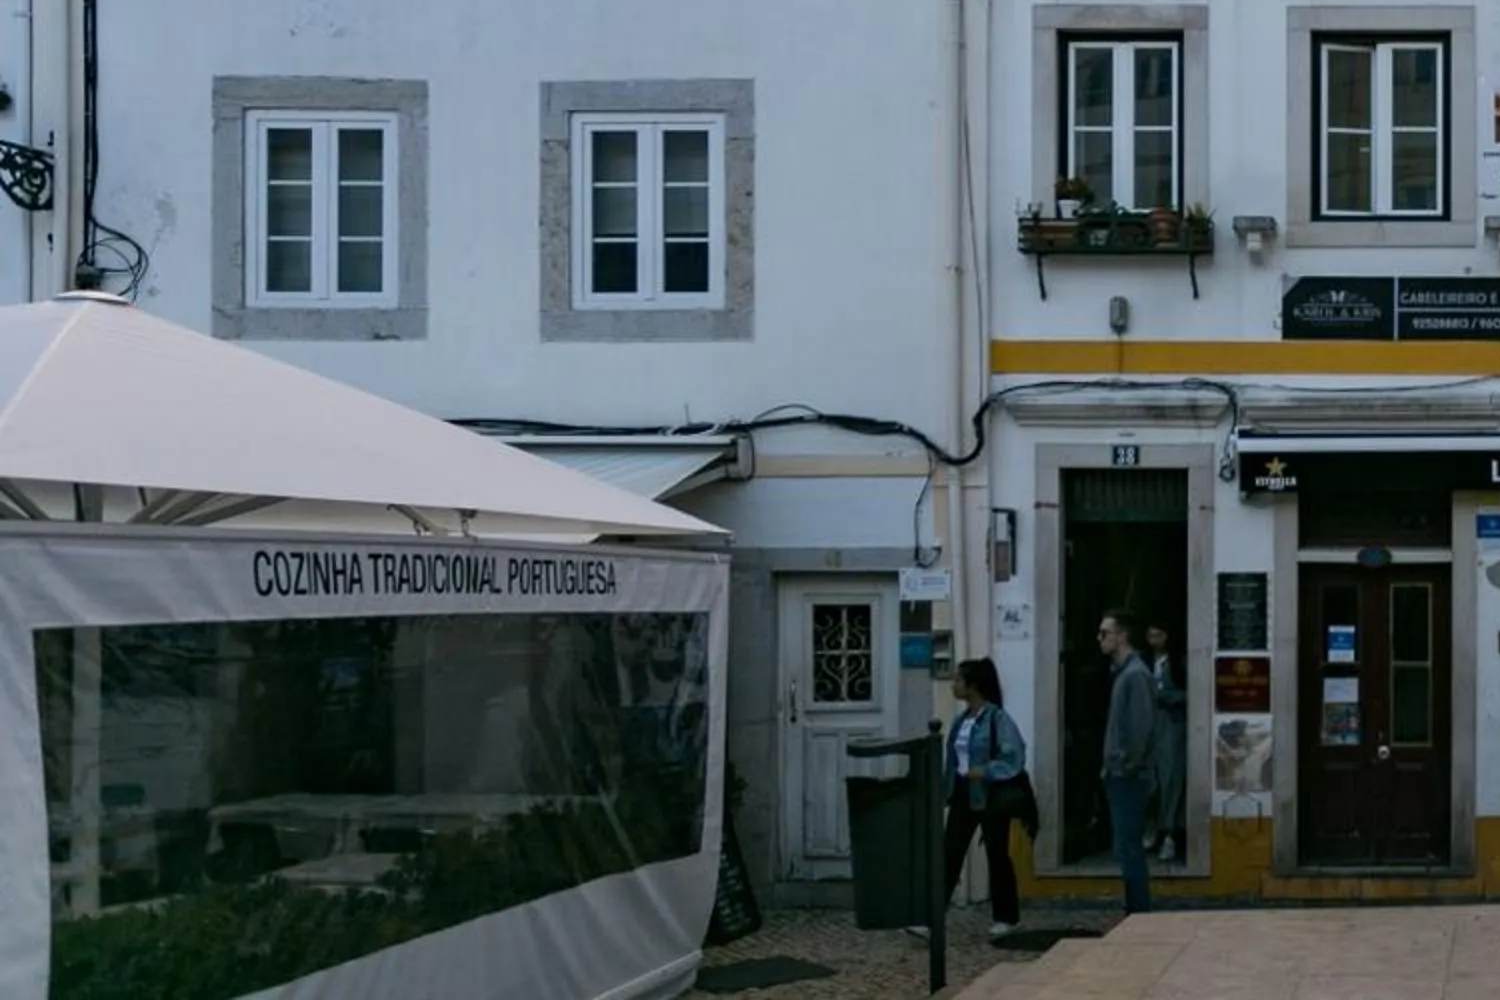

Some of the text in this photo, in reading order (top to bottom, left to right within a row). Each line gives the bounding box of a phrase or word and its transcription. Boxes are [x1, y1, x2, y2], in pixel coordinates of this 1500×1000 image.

[253, 550, 617, 597] COZINHA TRADICIONAL PORTUGUESA
